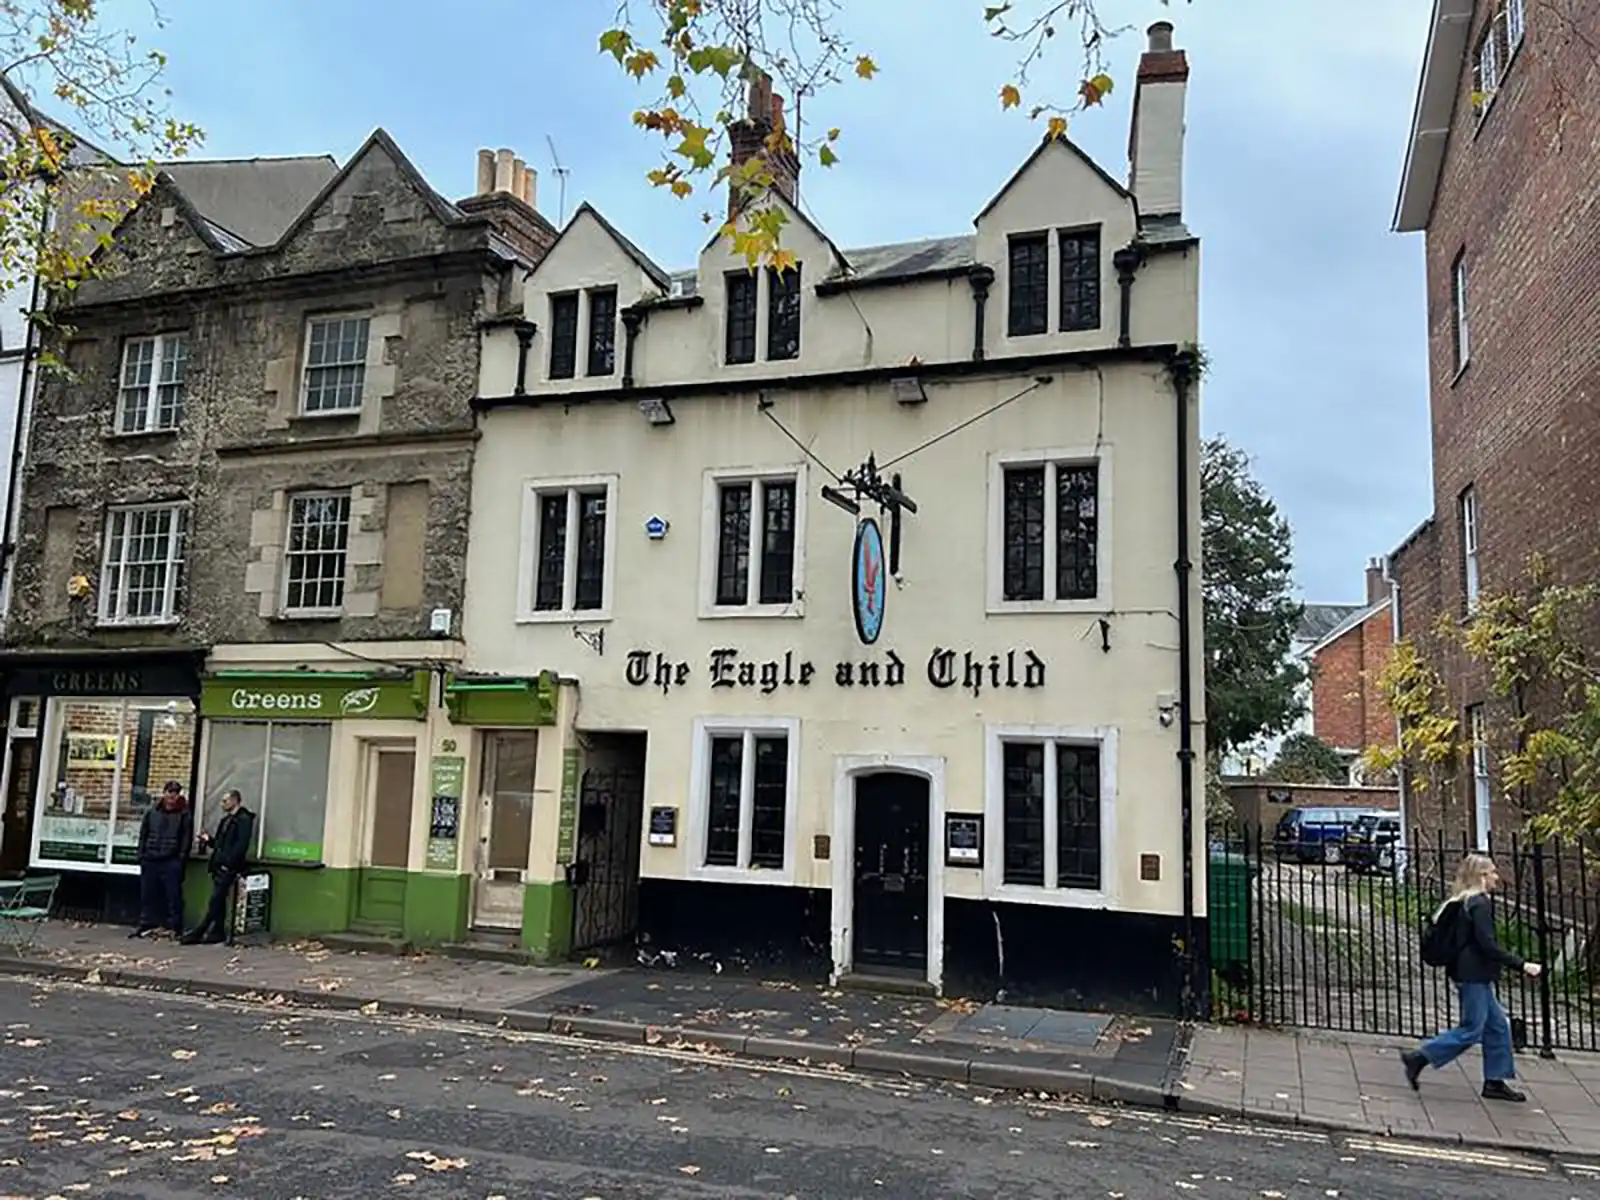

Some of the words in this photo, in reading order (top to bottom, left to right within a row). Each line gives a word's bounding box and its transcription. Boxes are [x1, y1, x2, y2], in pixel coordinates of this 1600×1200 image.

[53, 671, 141, 690] GREENS
[625, 650, 691, 694] The
[709, 648, 816, 693] Eagle
[835, 650, 905, 688] and
[927, 647, 1046, 696] Child
[231, 687, 322, 710] Greens
[442, 739, 457, 752] 50
